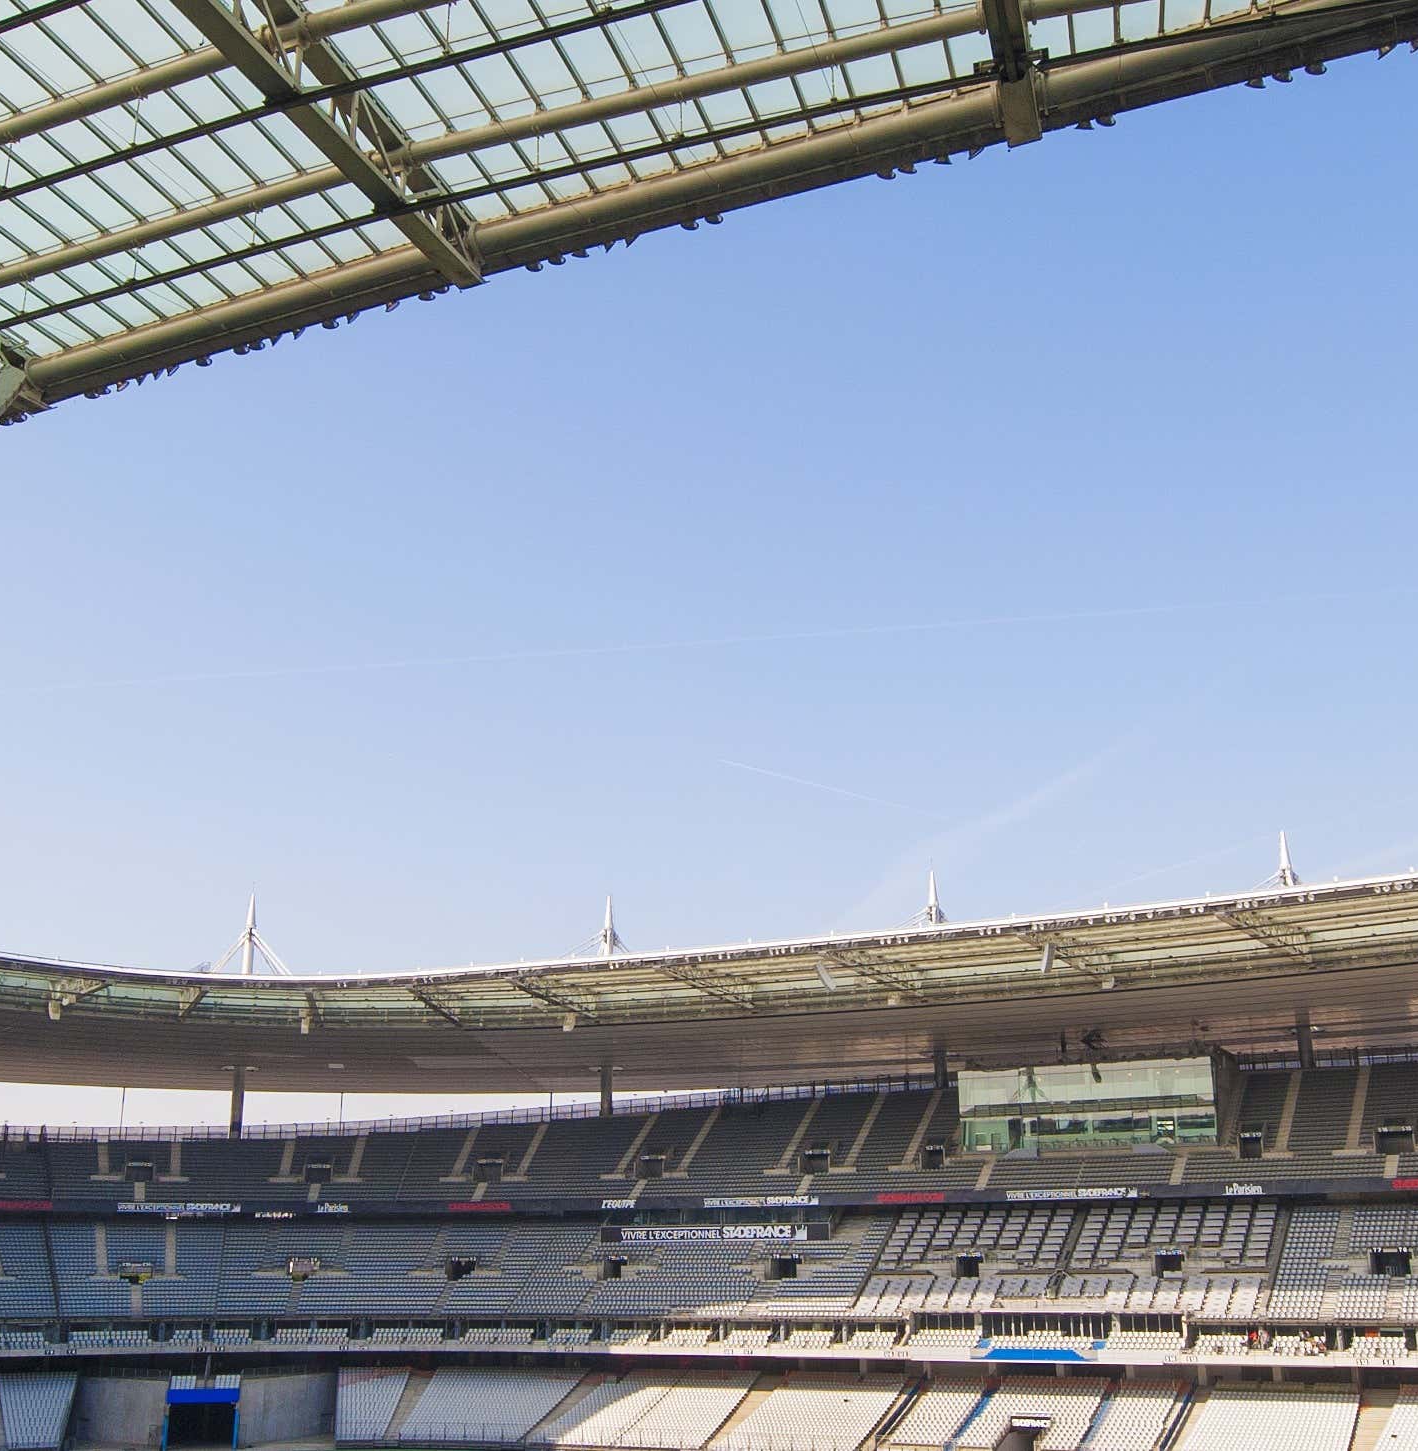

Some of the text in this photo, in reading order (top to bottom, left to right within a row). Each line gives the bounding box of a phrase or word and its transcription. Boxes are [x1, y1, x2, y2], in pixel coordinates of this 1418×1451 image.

[1233, 1182, 1263, 1195] Parisien
[620, 1226, 792, 1240] VIVRE L'EXCEPTIONNEL STADEFRANCE
